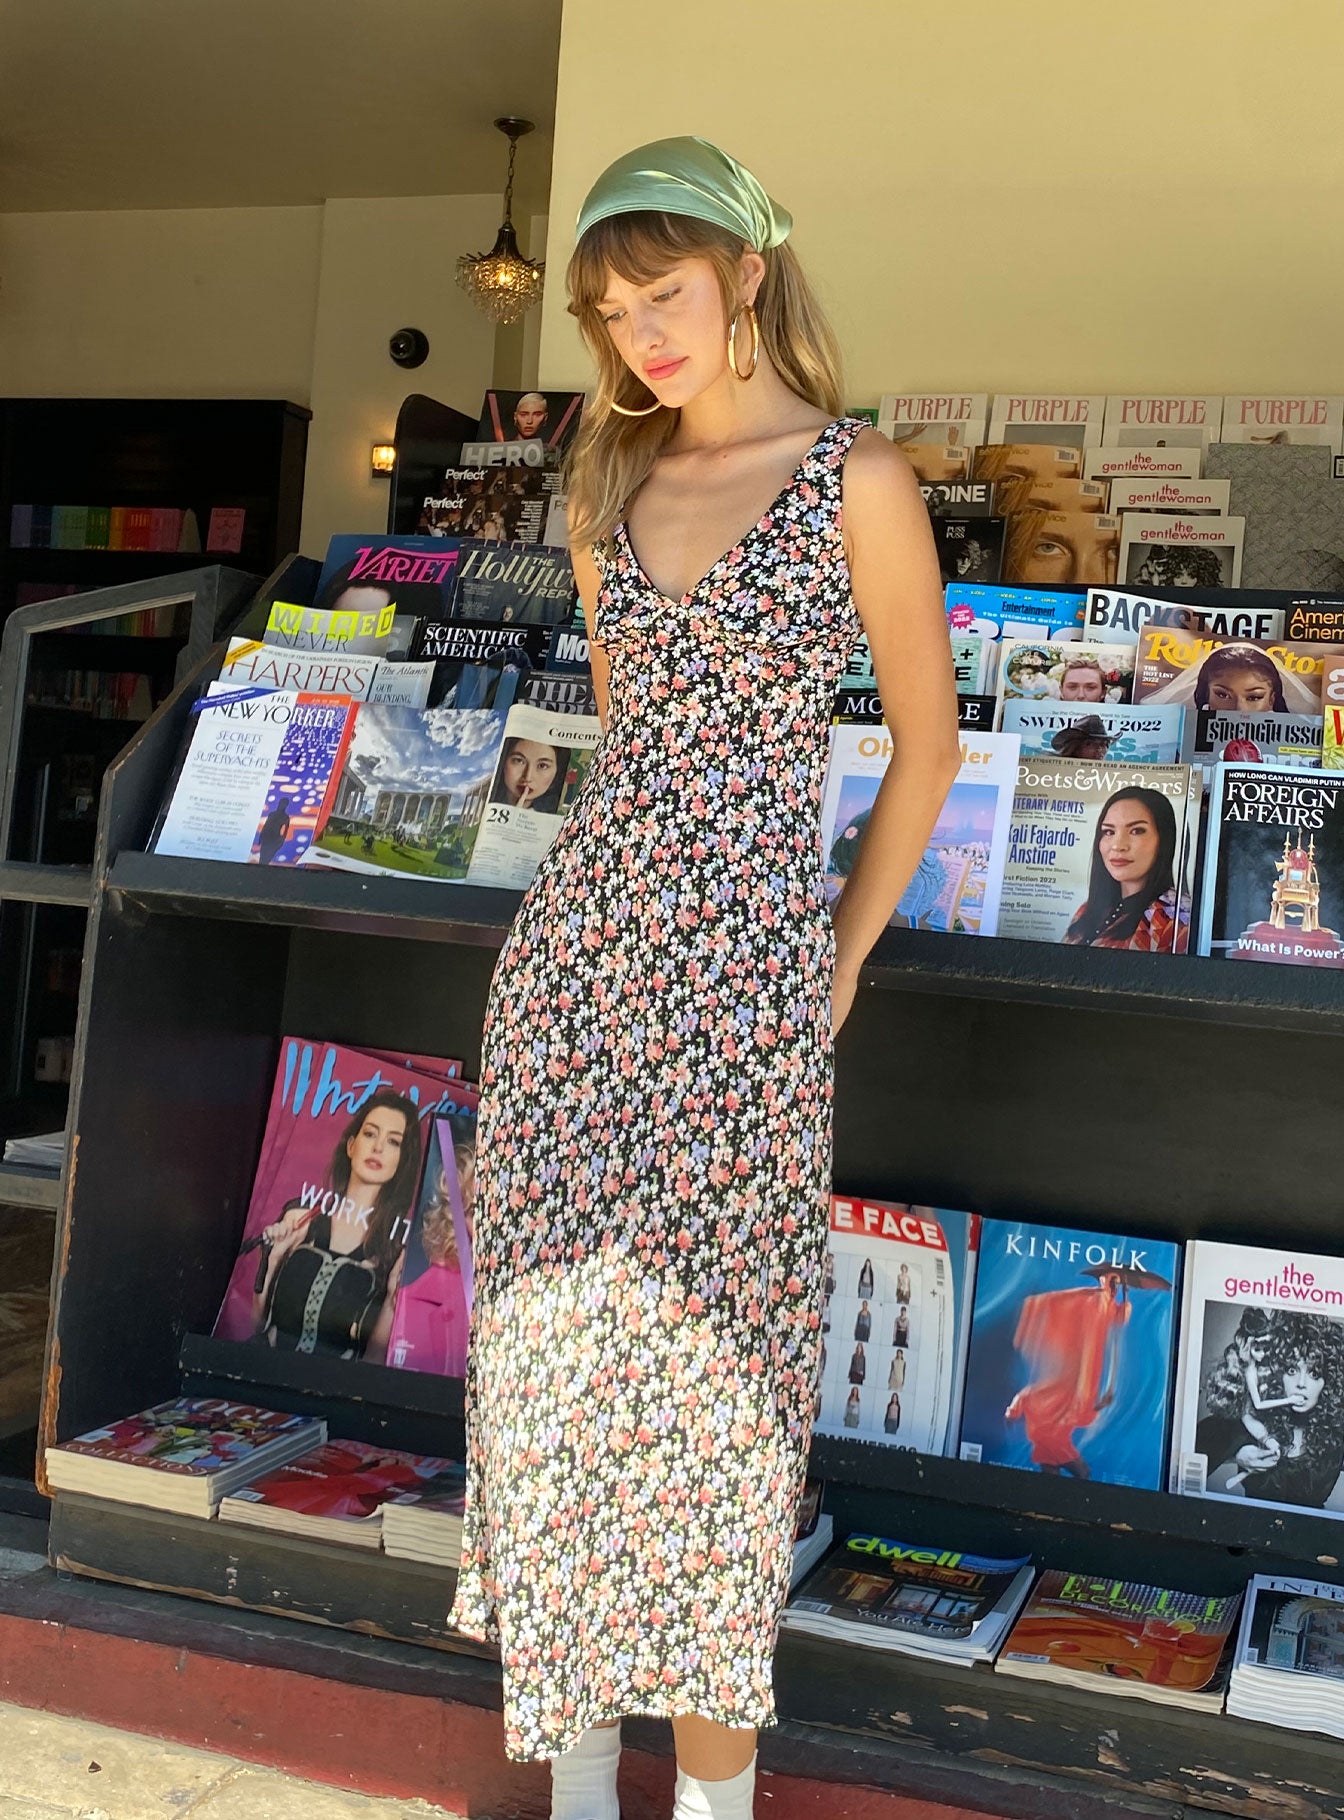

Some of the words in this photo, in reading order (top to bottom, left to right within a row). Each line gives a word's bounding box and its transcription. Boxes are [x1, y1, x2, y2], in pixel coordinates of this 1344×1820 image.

[893, 397, 973, 421] PURPLE
[1006, 399, 1090, 422] PURPLE
[1120, 399, 1207, 424] PURPLE
[1240, 399, 1328, 425] PURPLE
[465, 443, 541, 467] HERO
[1102, 457, 1183, 474] gentlewoman
[1134, 452, 1152, 463] the
[445, 469, 485, 481] Perfect
[921, 485, 986, 503] ROINE
[1128, 489, 1212, 505] gentlewoman
[1162, 484, 1180, 495] the
[424, 496, 465, 509] Perfect
[1140, 526, 1225, 541] gentlewoman
[1174, 521, 1193, 532] the
[347, 547, 458, 585] VARIET
[459, 550, 574, 595] Hollyw
[532, 557, 556, 567] THE
[1000, 613, 1036, 622] Ultimate
[1038, 617, 1062, 625] Guide
[1002, 601, 1055, 617] Entertainment
[1090, 593, 1273, 640] BACKSTAGE
[274, 605, 391, 638] WIRED
[276, 626, 349, 652] NEVER
[423, 626, 529, 647] SCIENTIFIC
[420, 643, 506, 660] AMERIC
[1015, 643, 1064, 652] CALIFORNIA
[1145, 632, 1221, 670] Rolli
[381, 666, 395, 675] The
[397, 666, 429, 676] Atlantic
[1013, 657, 1052, 666] CULTURE
[228, 655, 369, 694] HARPER'S
[271, 695, 290, 703] THE
[525, 680, 587, 704] THE
[213, 702, 260, 720] NEW
[263, 704, 336, 728] YORKER
[549, 727, 602, 741] Contents
[1120, 720, 1162, 732] 2022
[1209, 718, 1282, 745] STRENGTH
[1284, 724, 1324, 746] ISSU
[216, 730, 263, 744] SECRETS
[194, 751, 270, 768] SUPERYACHTS
[215, 743, 230, 752] OF
[236, 744, 257, 756] THE
[1284, 776, 1318, 784] VLADIMIR
[1012, 797, 1048, 811] ITERARY
[1050, 799, 1085, 814] AGENTS
[1227, 781, 1339, 809] FOREIGN
[487, 808, 510, 824] 28
[1224, 802, 1325, 829] AFFAIRS
[1030, 824, 1080, 849] Fajardo-
[1009, 844, 1056, 866] Anstine
[1238, 938, 1275, 955] What
[1279, 943, 1291, 956] Is
[300, 1182, 375, 1230] WORK
[862, 1206, 943, 1246] FACE
[1005, 1233, 1148, 1272] KINFOLK
[1282, 1262, 1315, 1286] the
[1224, 1275, 1344, 1305] gentlewom
[847, 1537, 963, 1568] dwell
[1060, 1590, 1222, 1624] DECORATION
[857, 1608, 889, 1622] You
[891, 1615, 924, 1628] Are
[930, 1621, 971, 1634] Here
